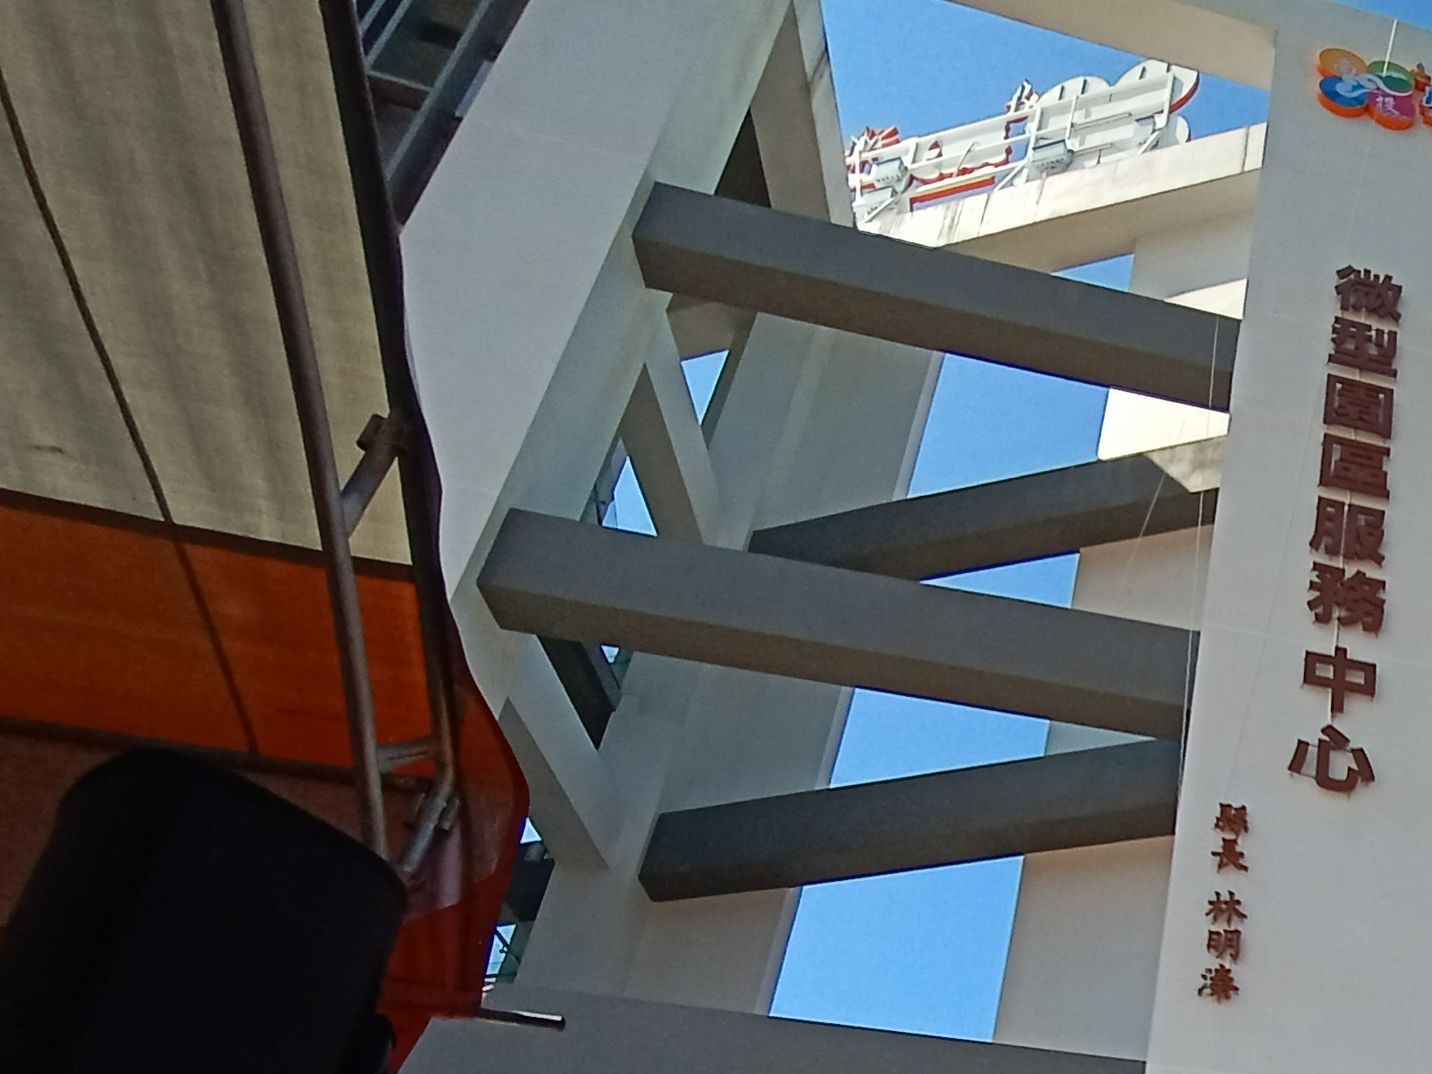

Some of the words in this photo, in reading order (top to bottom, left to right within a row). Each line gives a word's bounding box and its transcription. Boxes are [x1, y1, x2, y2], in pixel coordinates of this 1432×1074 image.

[1288, 264, 1403, 793] 微型園區服務中心
